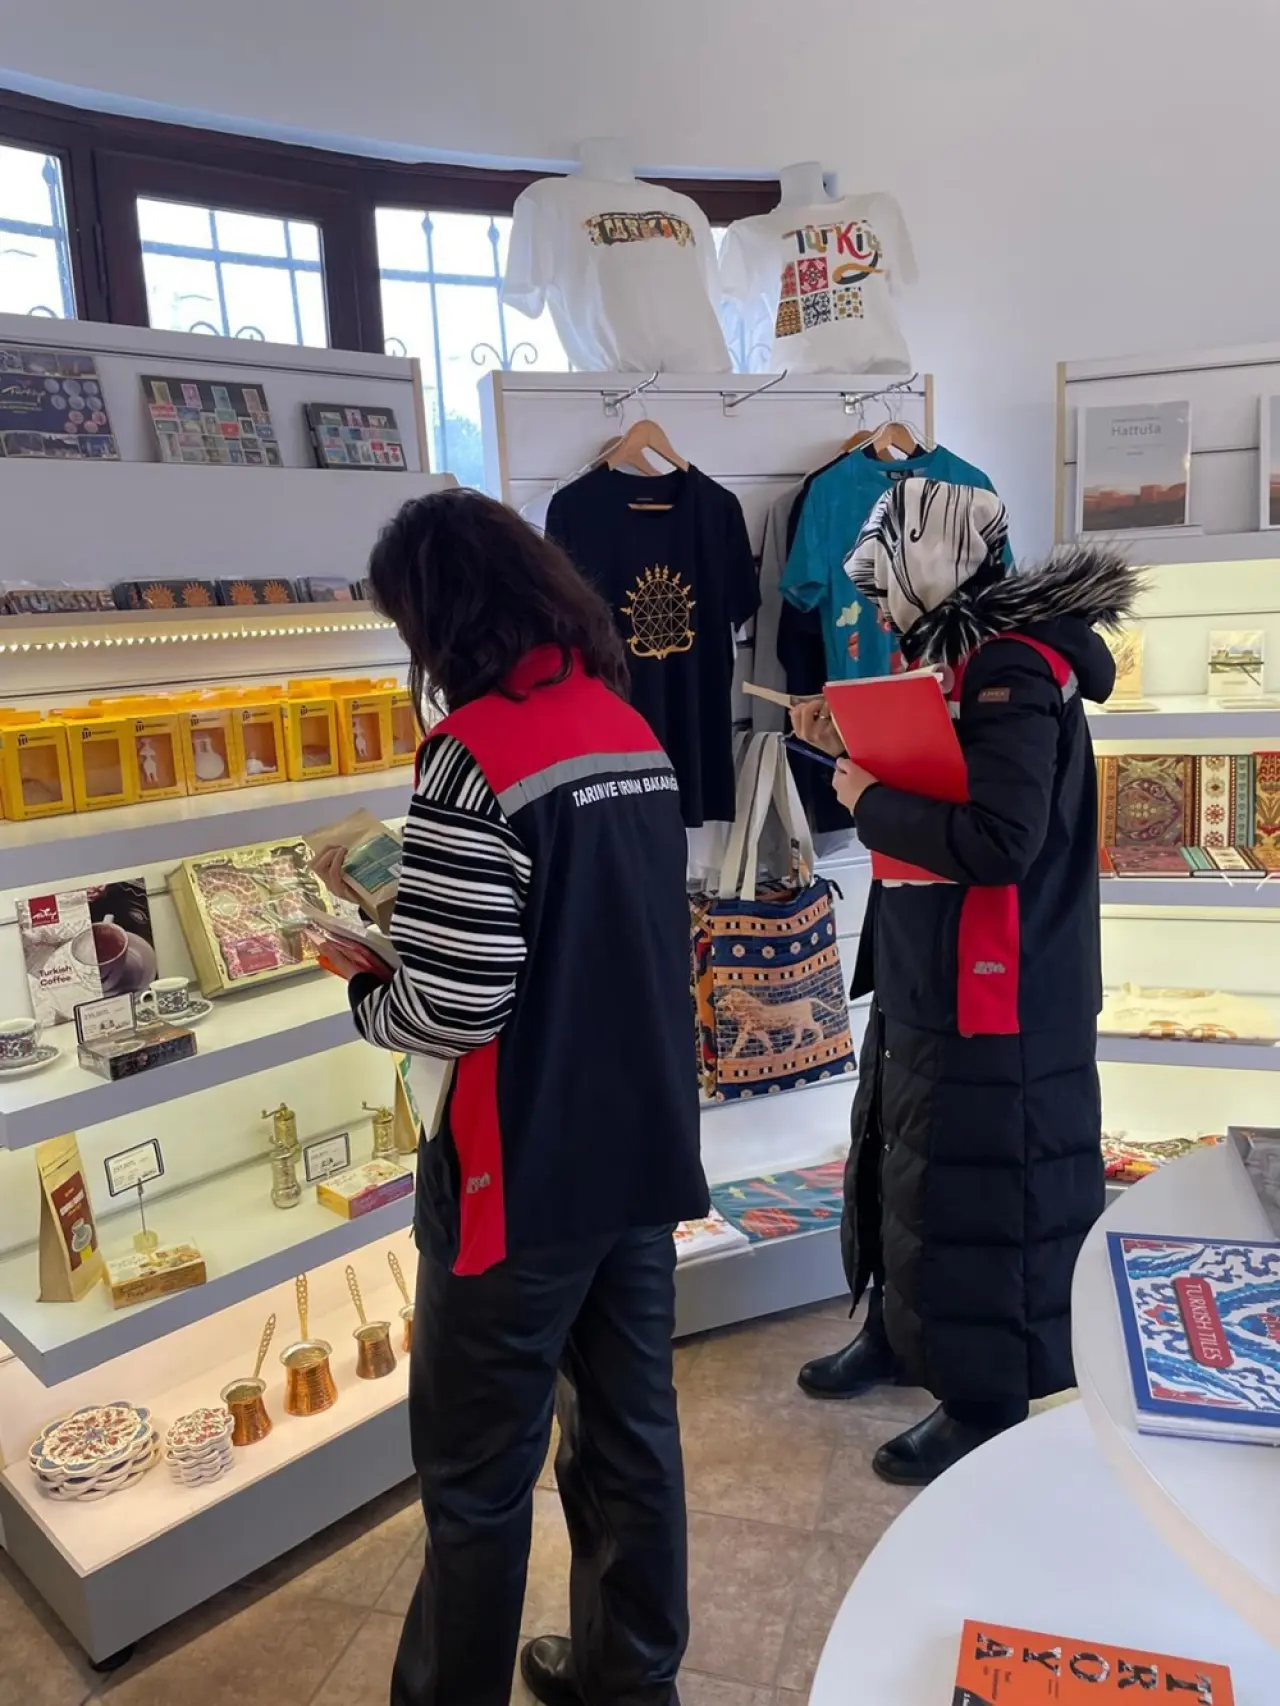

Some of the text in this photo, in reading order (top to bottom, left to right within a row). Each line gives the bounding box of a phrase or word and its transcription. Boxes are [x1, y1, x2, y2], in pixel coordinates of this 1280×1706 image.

[39, 964, 72, 977] Turkish
[40, 975, 72, 986] Coffee
[1184, 1284, 1223, 1361] TURKISH TILES
[975, 1632, 1213, 1705] TROYA
